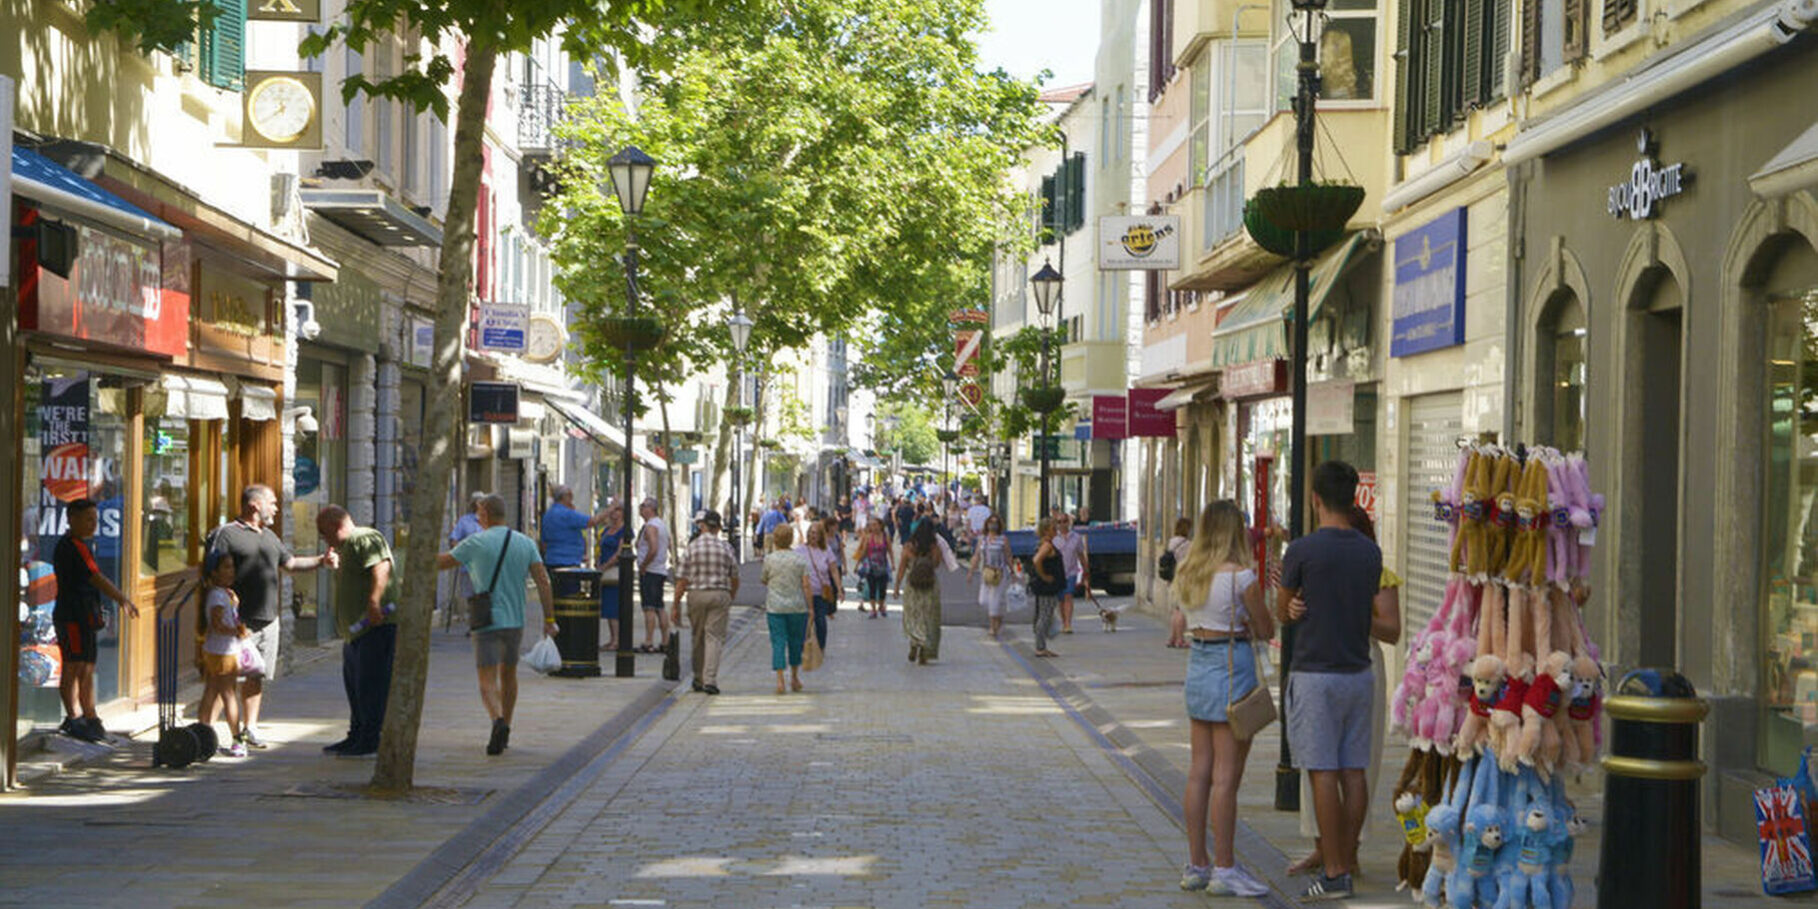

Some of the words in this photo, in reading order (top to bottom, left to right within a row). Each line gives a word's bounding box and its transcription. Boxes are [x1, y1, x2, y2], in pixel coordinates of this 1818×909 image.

[37, 406, 86, 421] WE'RE
[49, 421, 71, 433] THE
[38, 455, 114, 481] WALK
[38, 507, 120, 537] MAS
